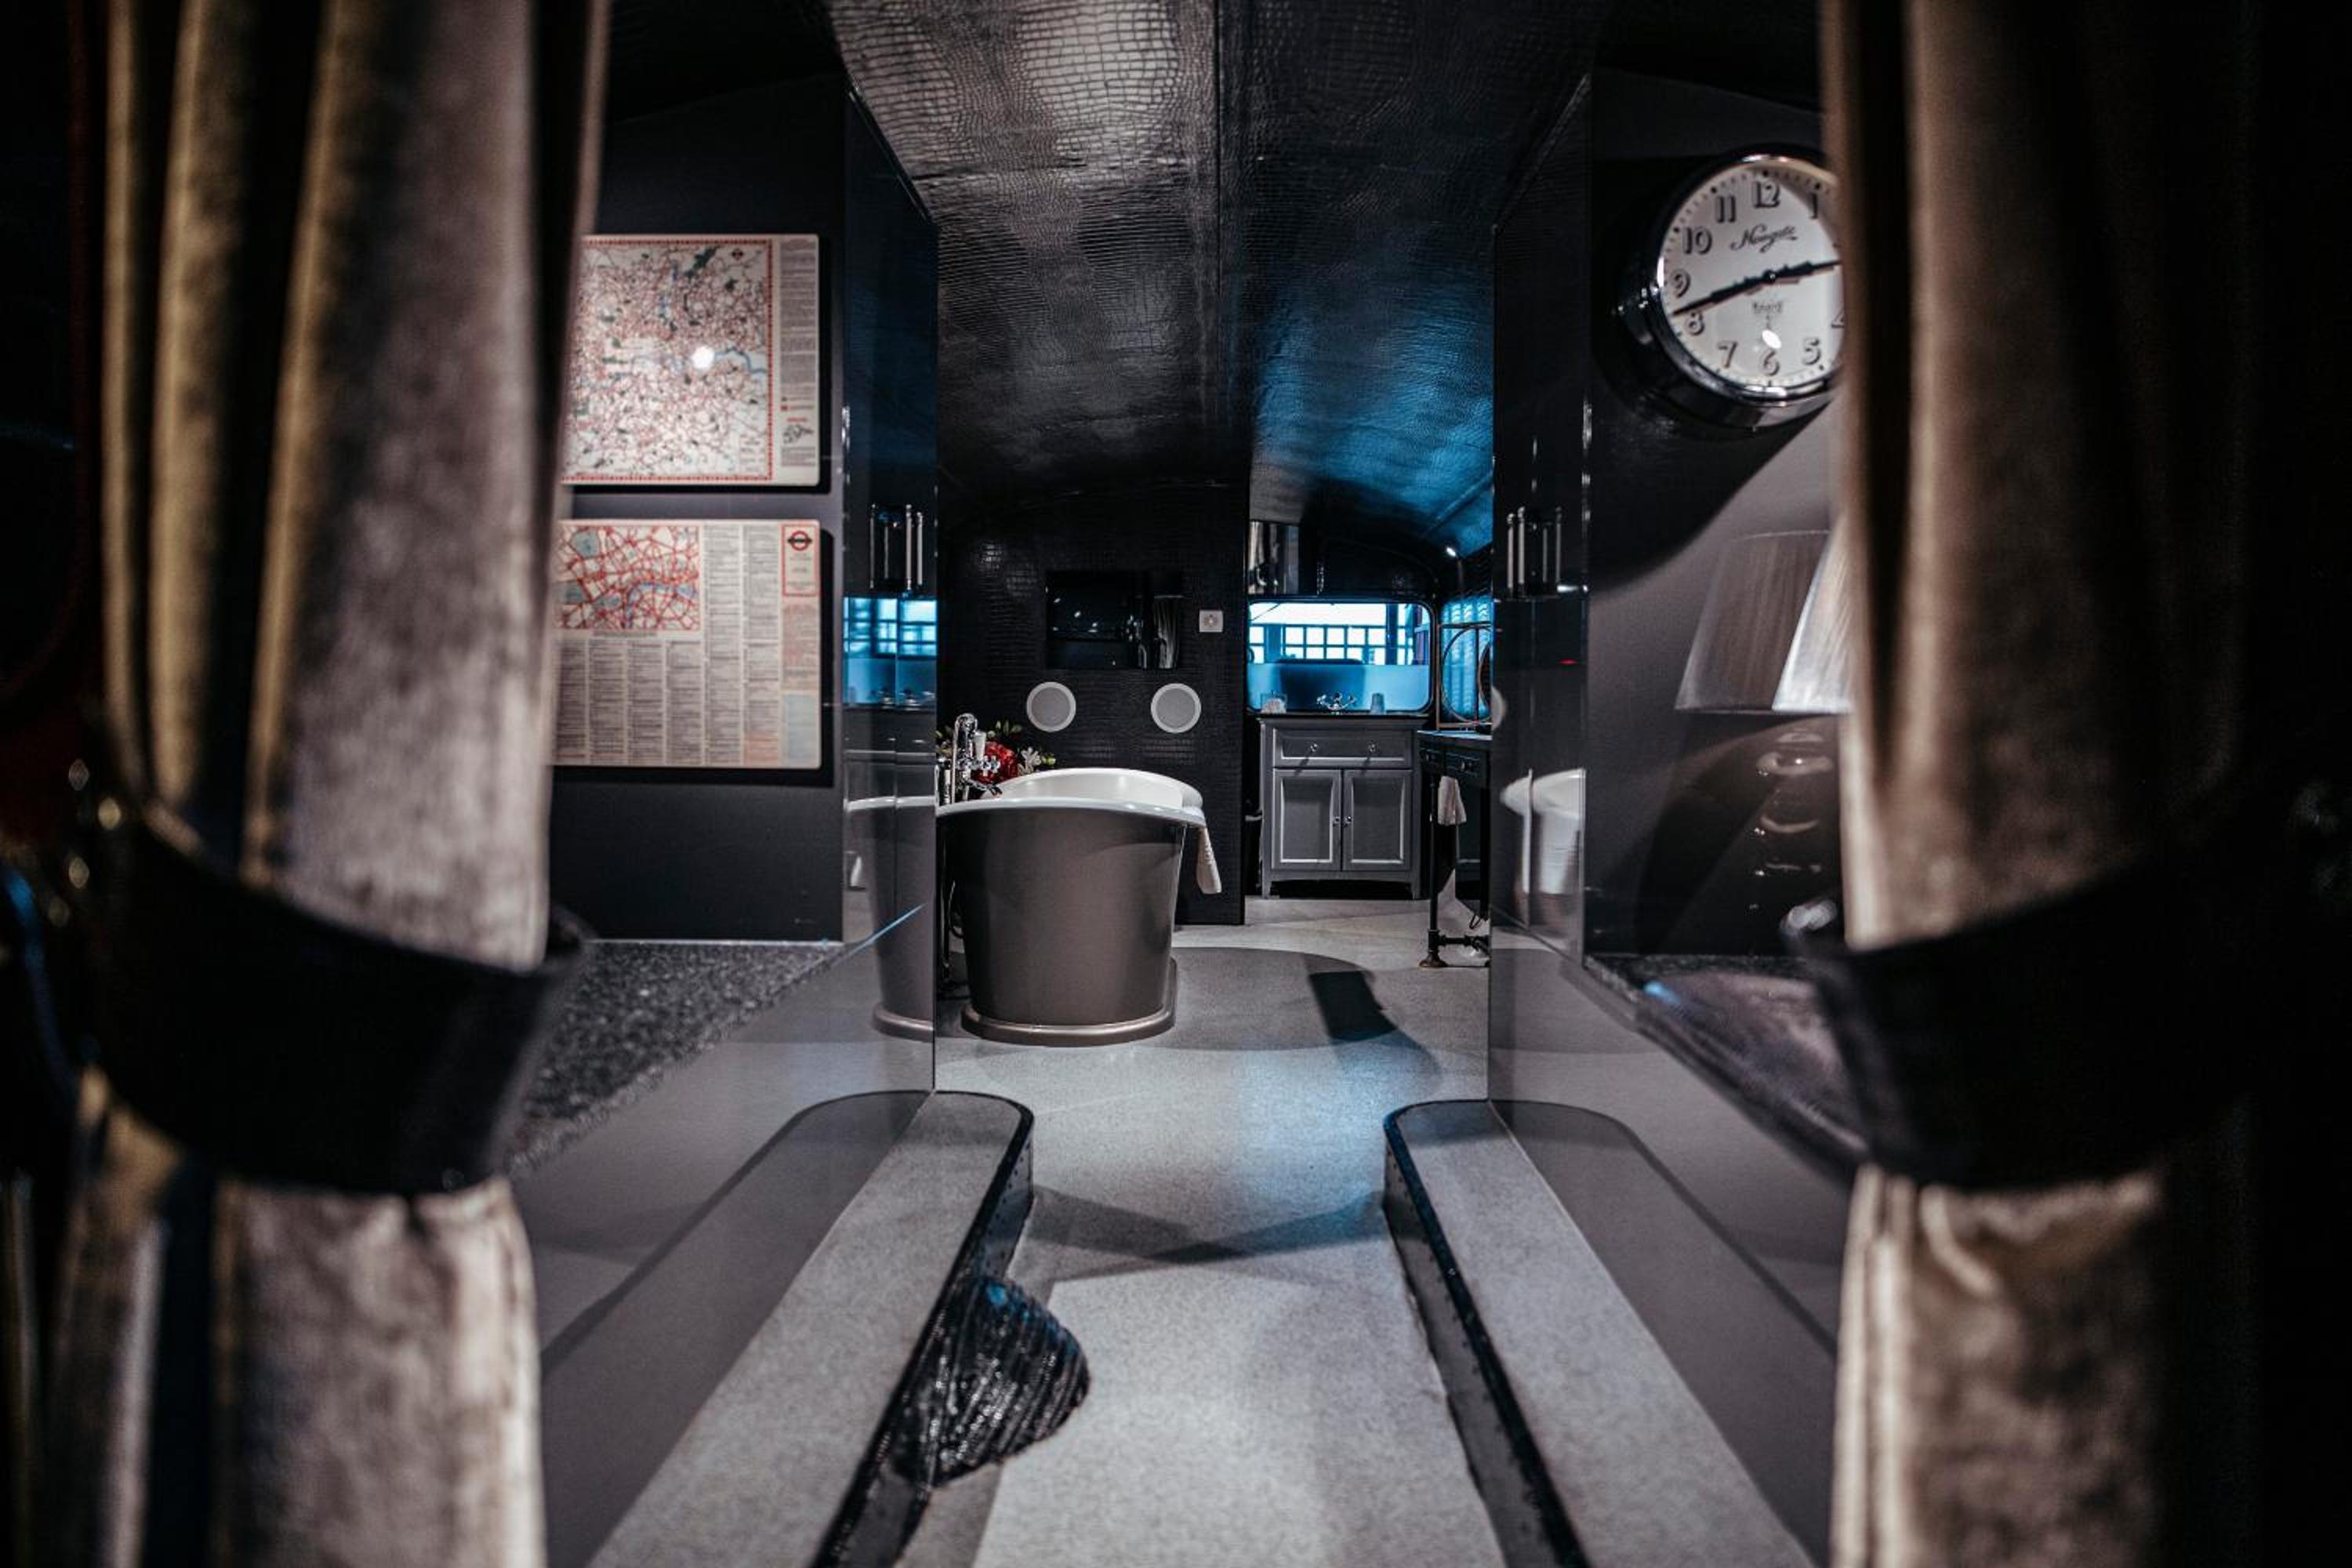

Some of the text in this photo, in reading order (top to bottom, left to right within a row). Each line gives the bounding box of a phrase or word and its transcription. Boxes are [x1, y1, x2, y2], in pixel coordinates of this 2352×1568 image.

[1753, 181, 1781, 209] 12
[1809, 193, 1819, 220] 1
[1717, 196, 1737, 223] 11
[1683, 227, 1712, 254] 10
[1672, 270, 1691, 297] 9
[1687, 310, 1704, 335] 8
[1718, 341, 1737, 368] 7
[1762, 350, 1780, 376] 6
[1802, 338, 1820, 365] 5
